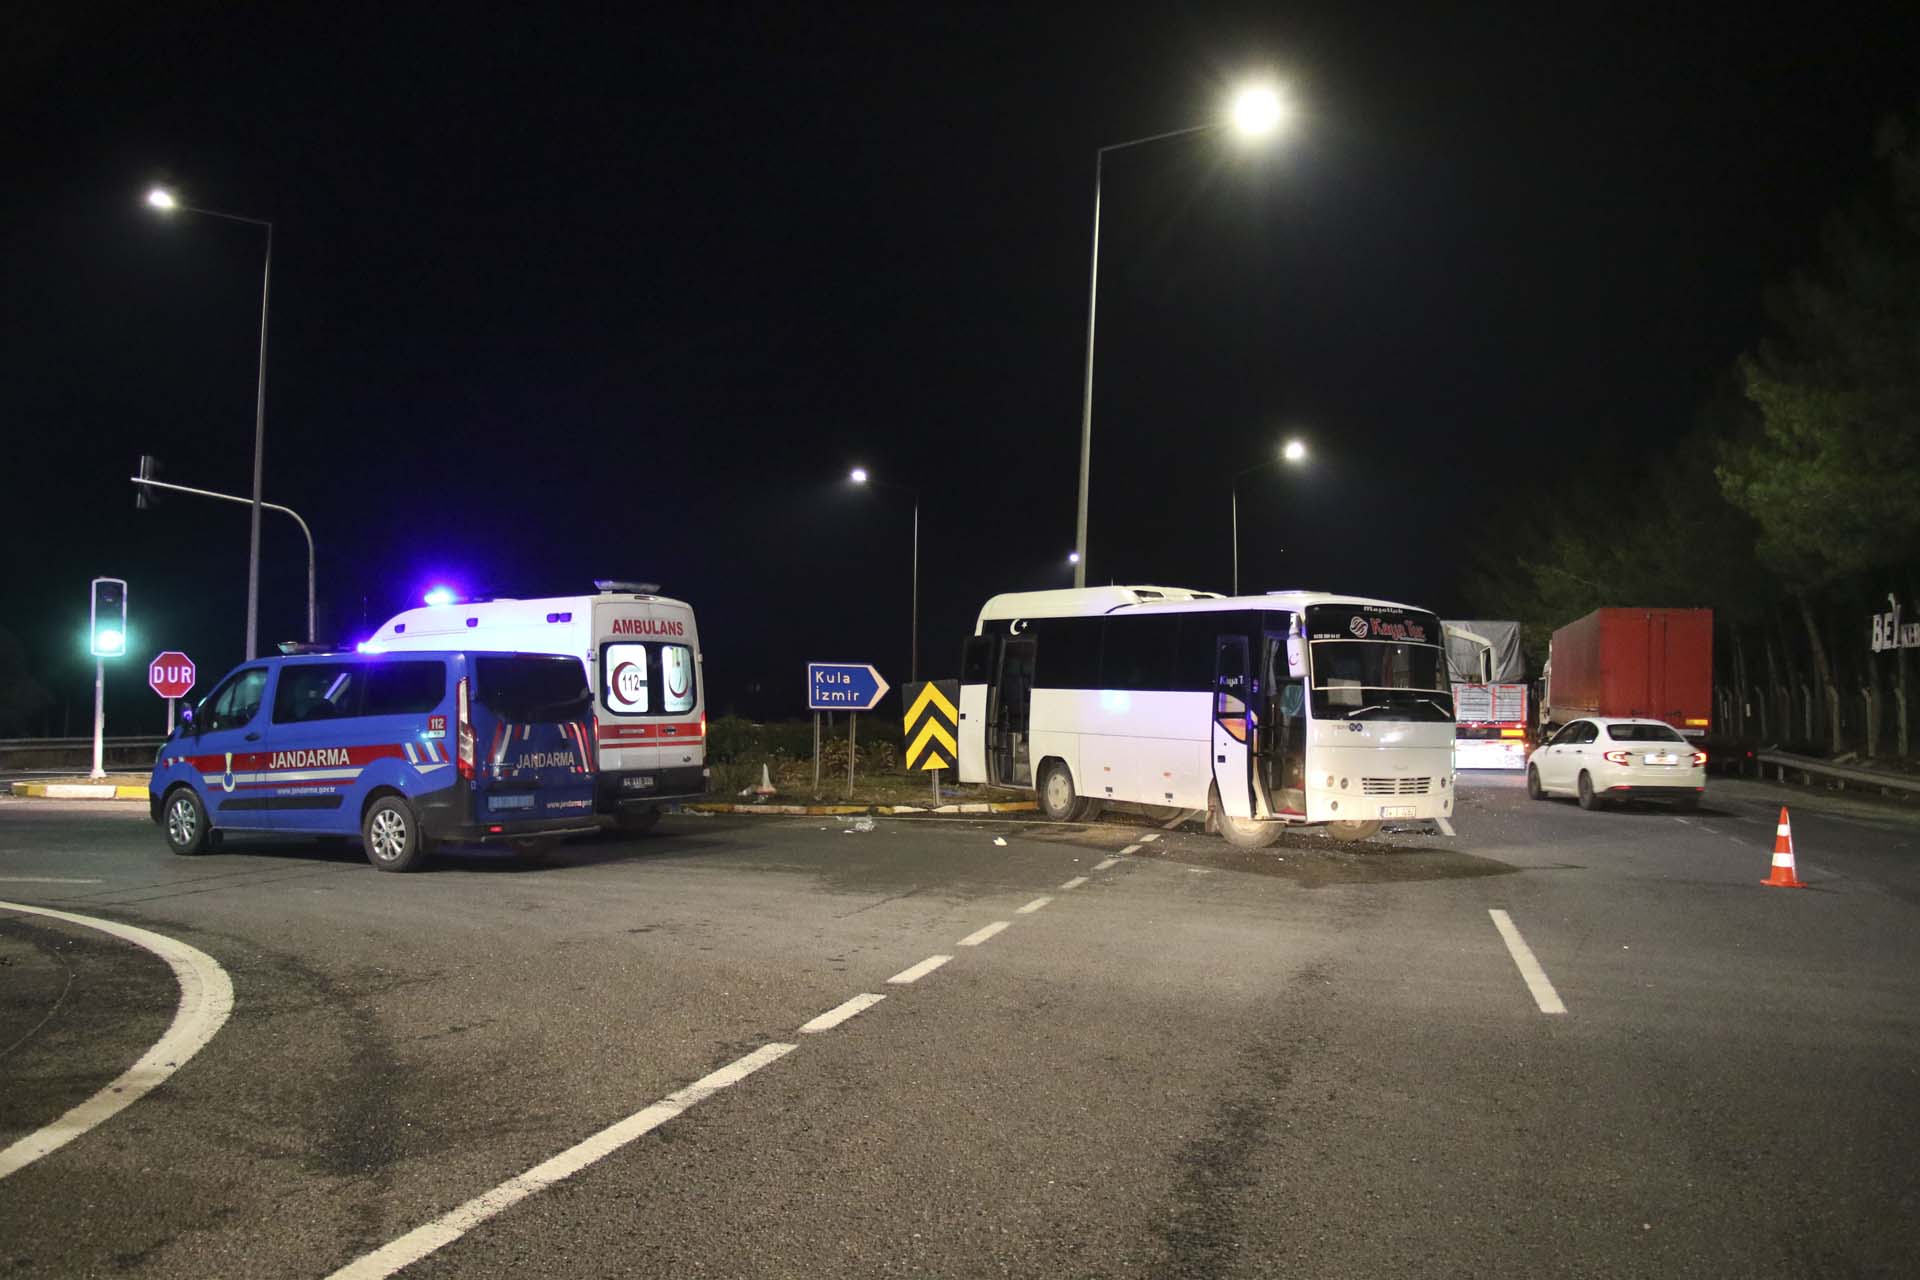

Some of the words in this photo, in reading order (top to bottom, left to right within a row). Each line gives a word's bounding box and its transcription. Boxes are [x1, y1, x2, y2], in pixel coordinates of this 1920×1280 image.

[612, 618, 684, 636] AMBULANS
[153, 666, 192, 684] DUR
[622, 674, 640, 691] 112
[815, 671, 851, 684] Kula
[815, 685, 860, 702] İzmir
[431, 718, 444, 730] 112
[269, 748, 351, 769] JANDARMA
[516, 751, 576, 769] JANDARMA
